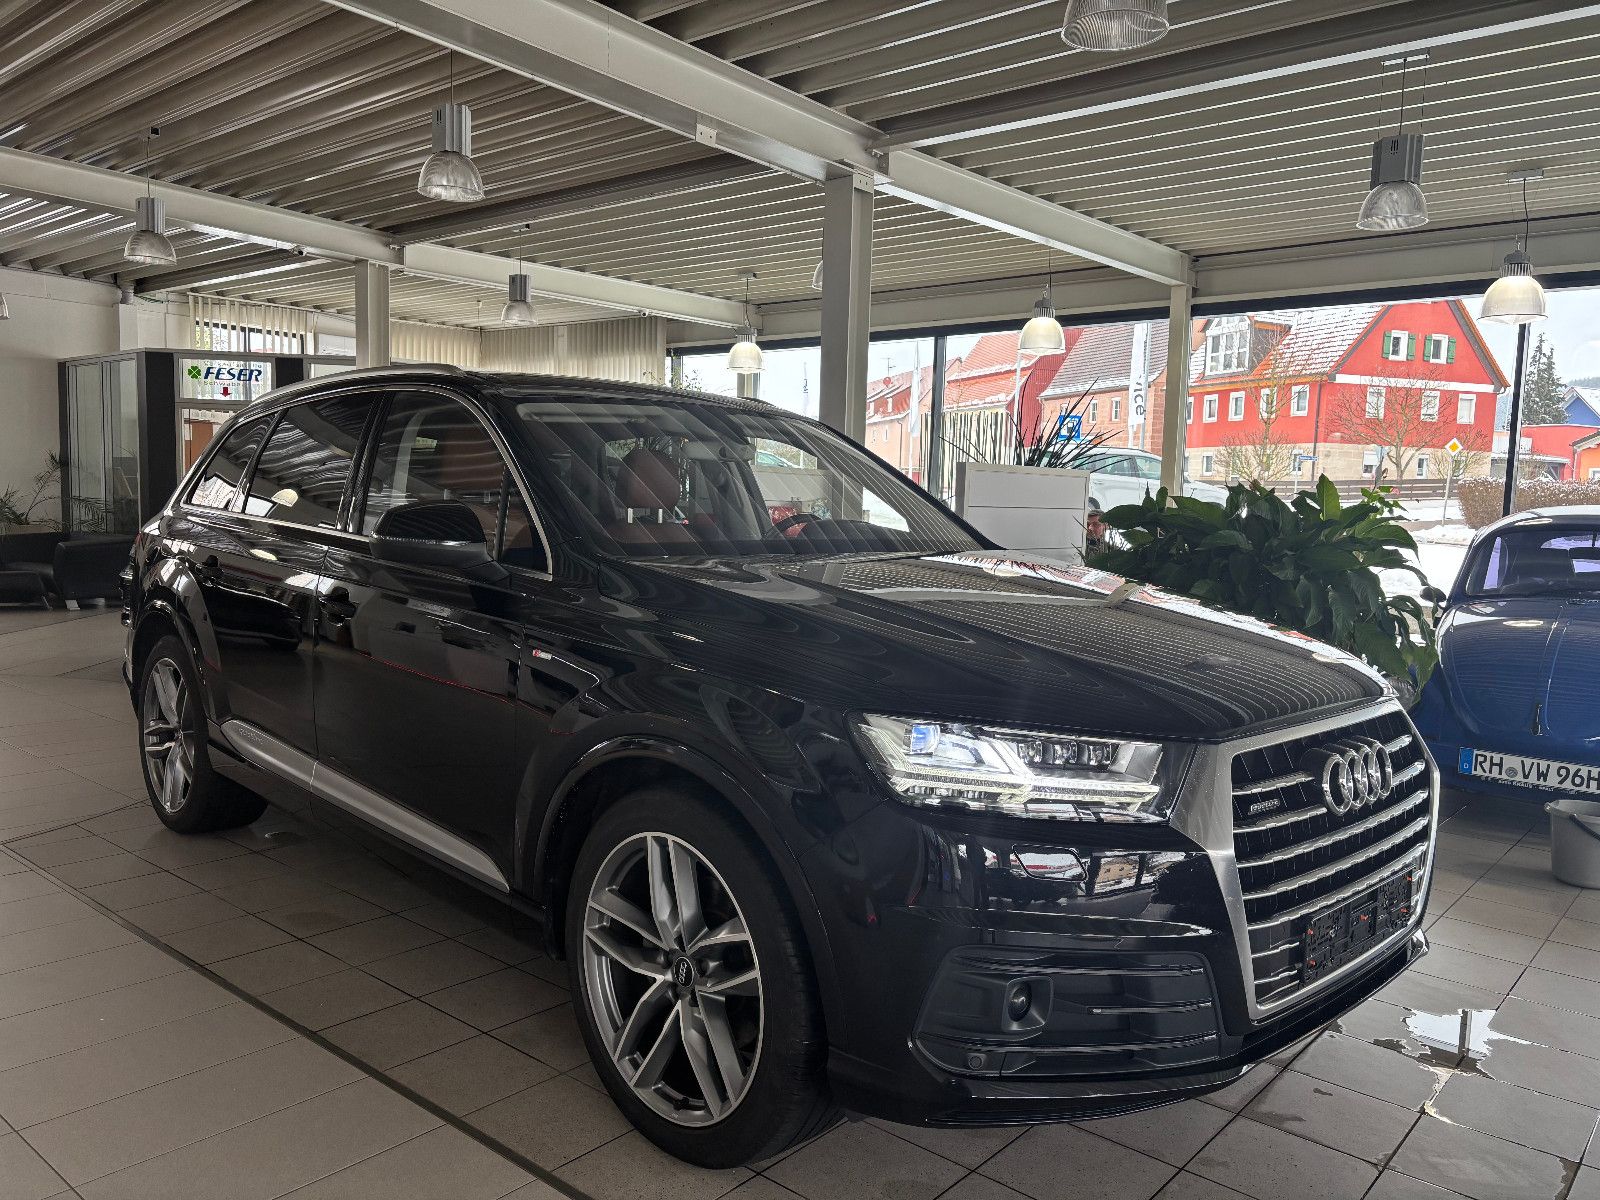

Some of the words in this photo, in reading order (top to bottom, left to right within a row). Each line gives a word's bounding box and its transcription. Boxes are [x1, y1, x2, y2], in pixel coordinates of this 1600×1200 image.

[204, 366, 262, 382] FESER
[1474, 753, 1503, 775] RH
[1521, 760, 1550, 782] VW
[1556, 766, 1600, 790] 96H
